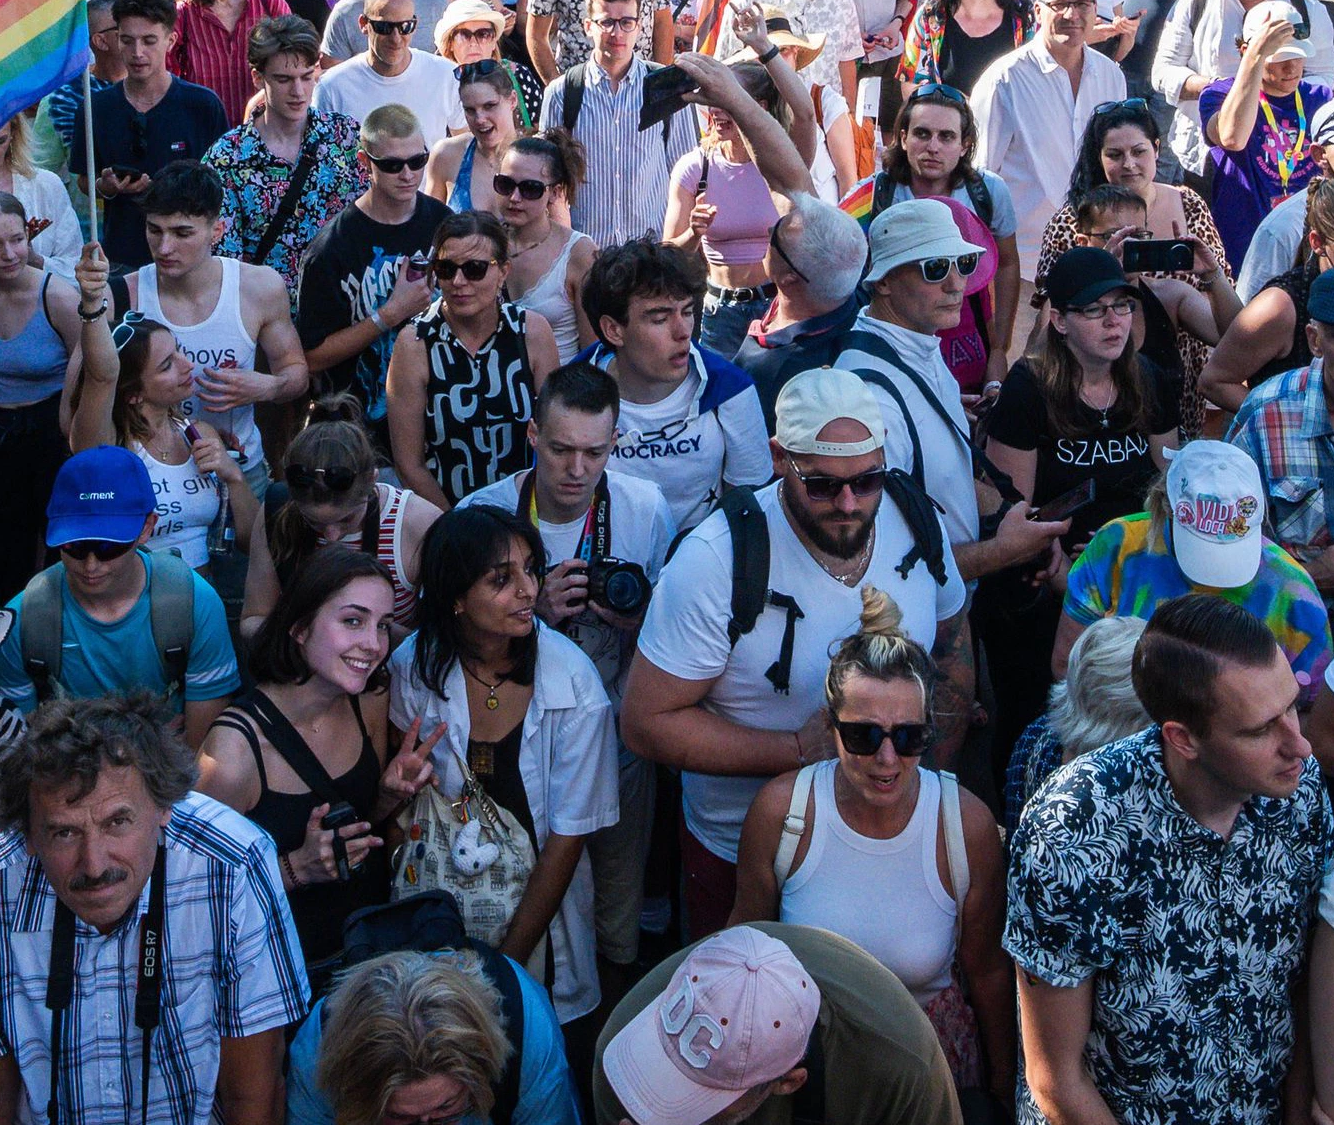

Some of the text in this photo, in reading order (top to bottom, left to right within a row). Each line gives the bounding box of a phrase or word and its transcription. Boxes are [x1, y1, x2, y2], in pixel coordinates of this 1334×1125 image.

[1256, 156, 1280, 180] BUDAPES
[951, 334, 984, 368] AY
[611, 434, 702, 460] MOCRACY
[151, 478, 171, 495] ot
[155, 501, 183, 517] ss
[150, 520, 184, 537] irls
[597, 501, 606, 555] EOS DIGIT
[1199, 518, 1225, 535] LOCA
[144, 929, 157, 978] EOS R7
[660, 974, 724, 1069] DC
